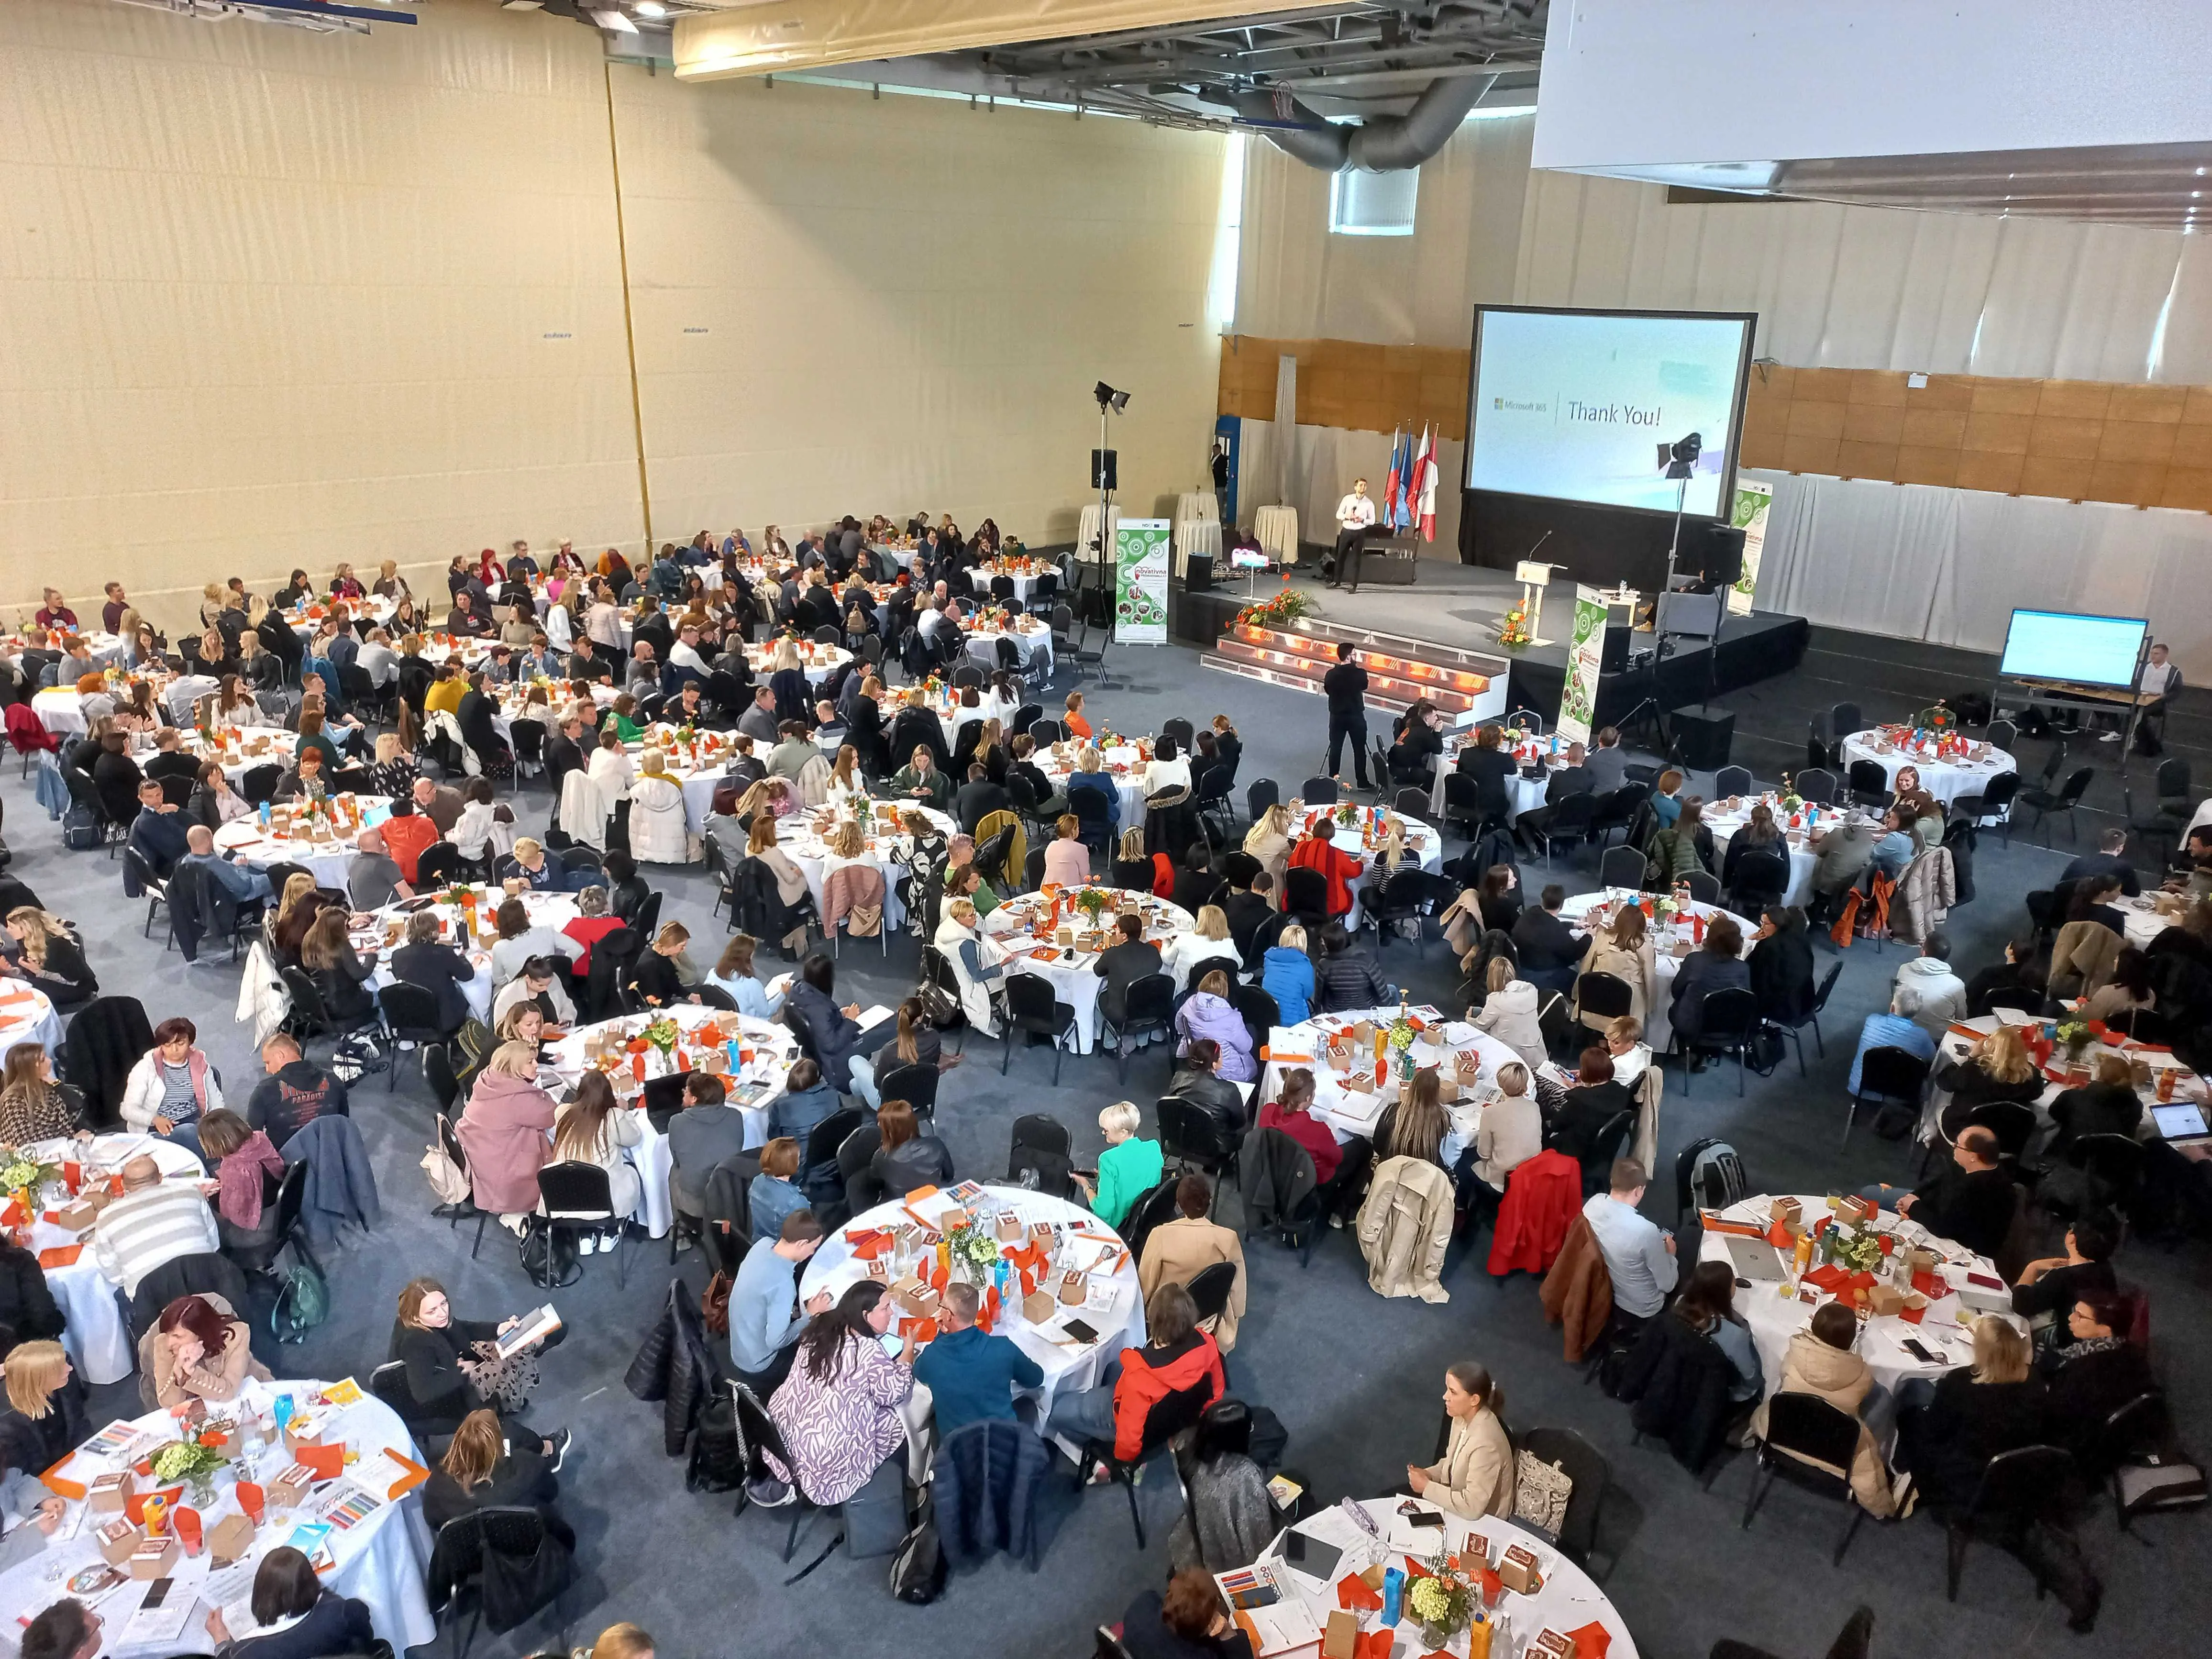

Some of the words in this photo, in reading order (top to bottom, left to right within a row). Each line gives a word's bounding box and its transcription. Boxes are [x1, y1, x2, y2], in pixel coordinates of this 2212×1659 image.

[1504, 400, 1533, 411] Microsoft
[1569, 398, 1618, 423] Thank
[1624, 405, 1660, 426] You!
